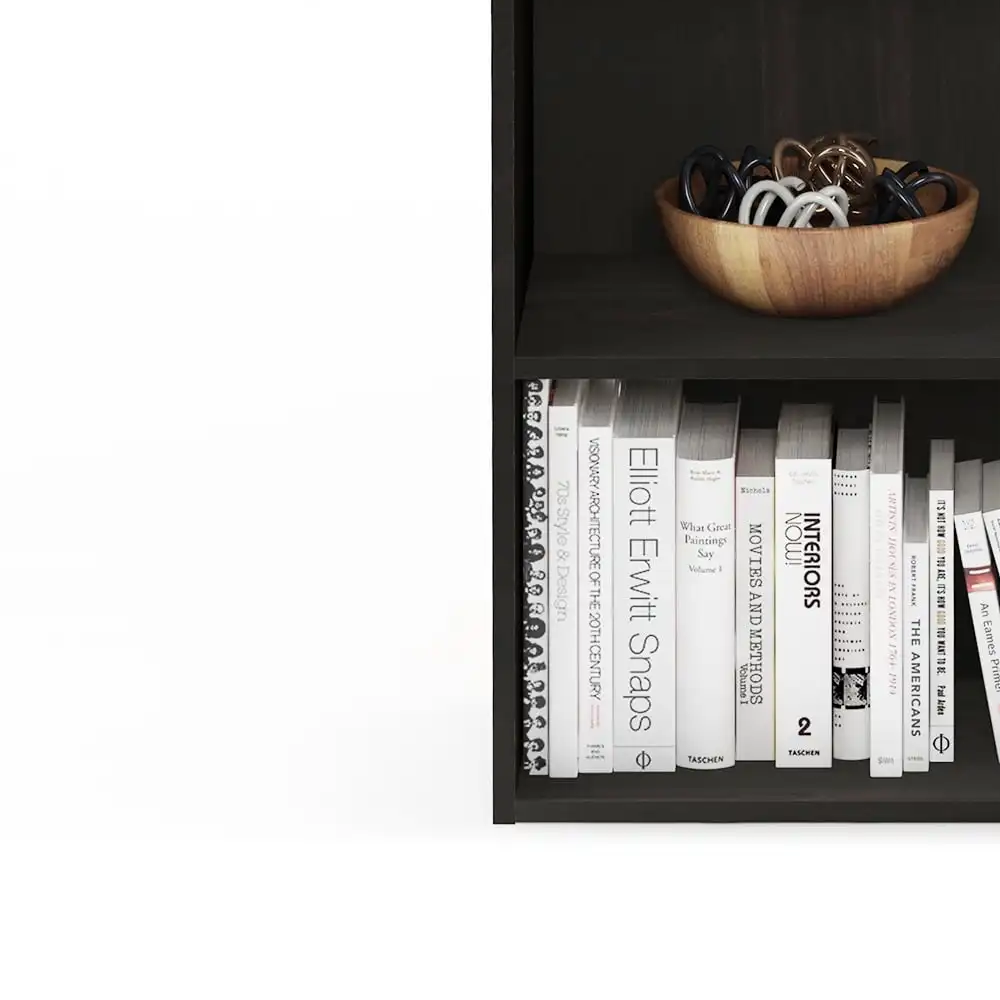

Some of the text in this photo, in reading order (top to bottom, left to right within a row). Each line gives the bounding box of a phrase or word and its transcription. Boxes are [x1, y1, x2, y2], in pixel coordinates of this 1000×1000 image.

[740, 486, 770, 494] Nichols
[936, 500, 946, 511] IT'S
[680, 520, 732, 532] What Great
[936, 512, 946, 524] NOT
[784, 512, 803, 566] NOW!
[936, 524, 946, 538] HOW
[684, 534, 728, 548] Paintings
[554, 480, 570, 622] 70s Style & Design
[698, 548, 715, 560] Say
[588, 437, 602, 701] VISIONARY ARCHITECTURE OF THE 20TH CENTURY
[688, 564, 716, 574] Volume
[803, 512, 822, 610] INTERIORS
[936, 556, 946, 568] YOU
[910, 554, 919, 607] ROBERT FRANK
[622, 447, 660, 732] Elliott Erwitt Snaps
[936, 596, 946, 609] HOW
[980, 602, 990, 618] An
[749, 523, 764, 706] MOVIES AND METHODS
[888, 594, 898, 641] LONDON
[936, 627, 946, 639] YOU
[982, 620, 997, 656] Eames
[936, 639, 946, 656] WANT
[740, 663, 748, 699] Volume
[910, 618, 922, 737] THE AMERICANS
[936, 684, 946, 716] Paul Arden
[798, 716, 812, 736] 2
[688, 755, 724, 764] TASCHEN
[788, 749, 820, 757] TASCHEN
